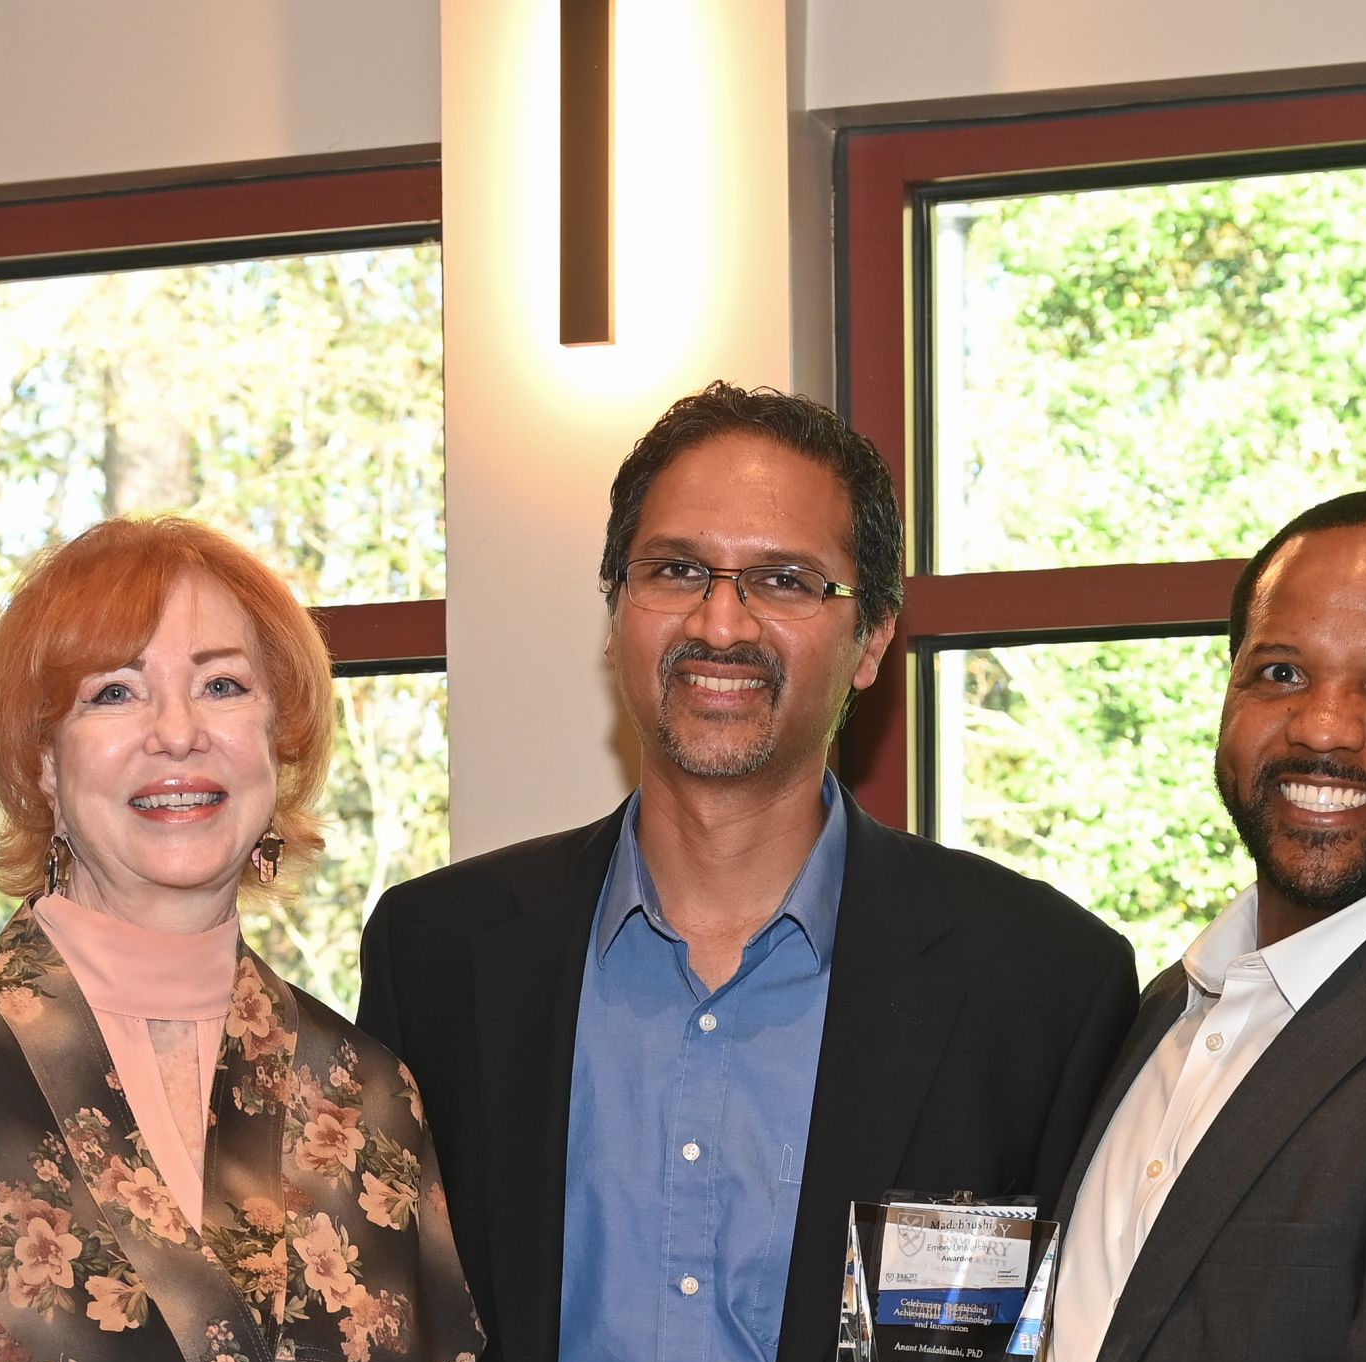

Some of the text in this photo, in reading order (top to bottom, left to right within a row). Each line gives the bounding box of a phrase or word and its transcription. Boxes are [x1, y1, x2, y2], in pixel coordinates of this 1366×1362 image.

[929, 1322, 969, 1333] Innovation
[894, 1342, 983, 1358] Anant Madabhushi, PhD
